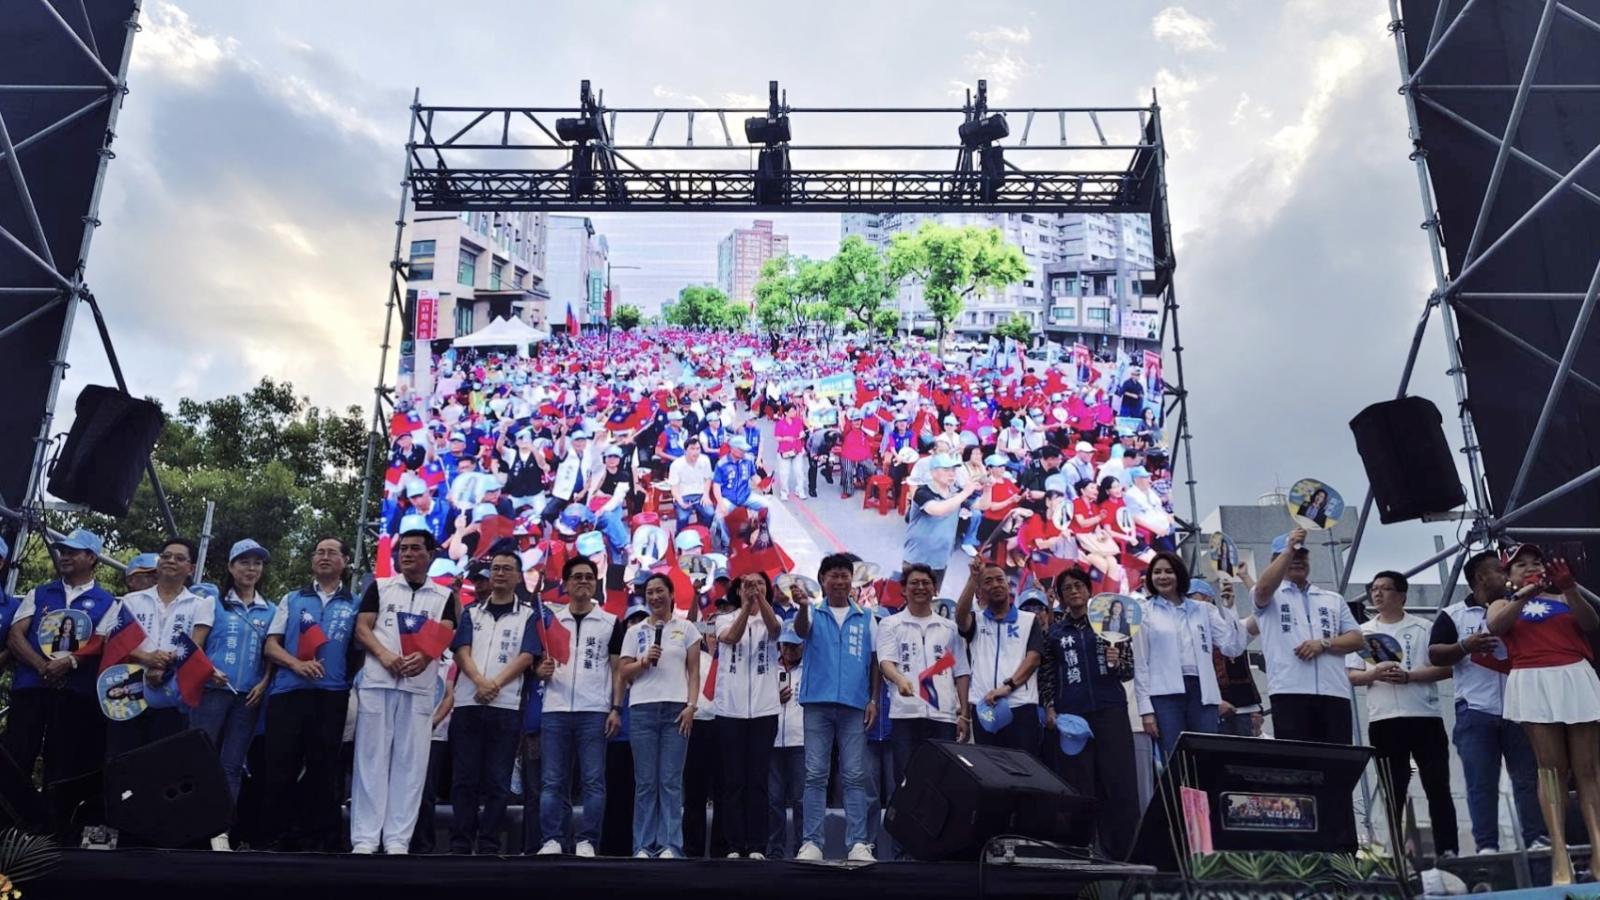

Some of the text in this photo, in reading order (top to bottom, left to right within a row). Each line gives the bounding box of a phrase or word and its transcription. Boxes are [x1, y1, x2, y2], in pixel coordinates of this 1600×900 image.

[584, 637, 596, 669] 吳秀華
[757, 640, 766, 674] 吳秀華
